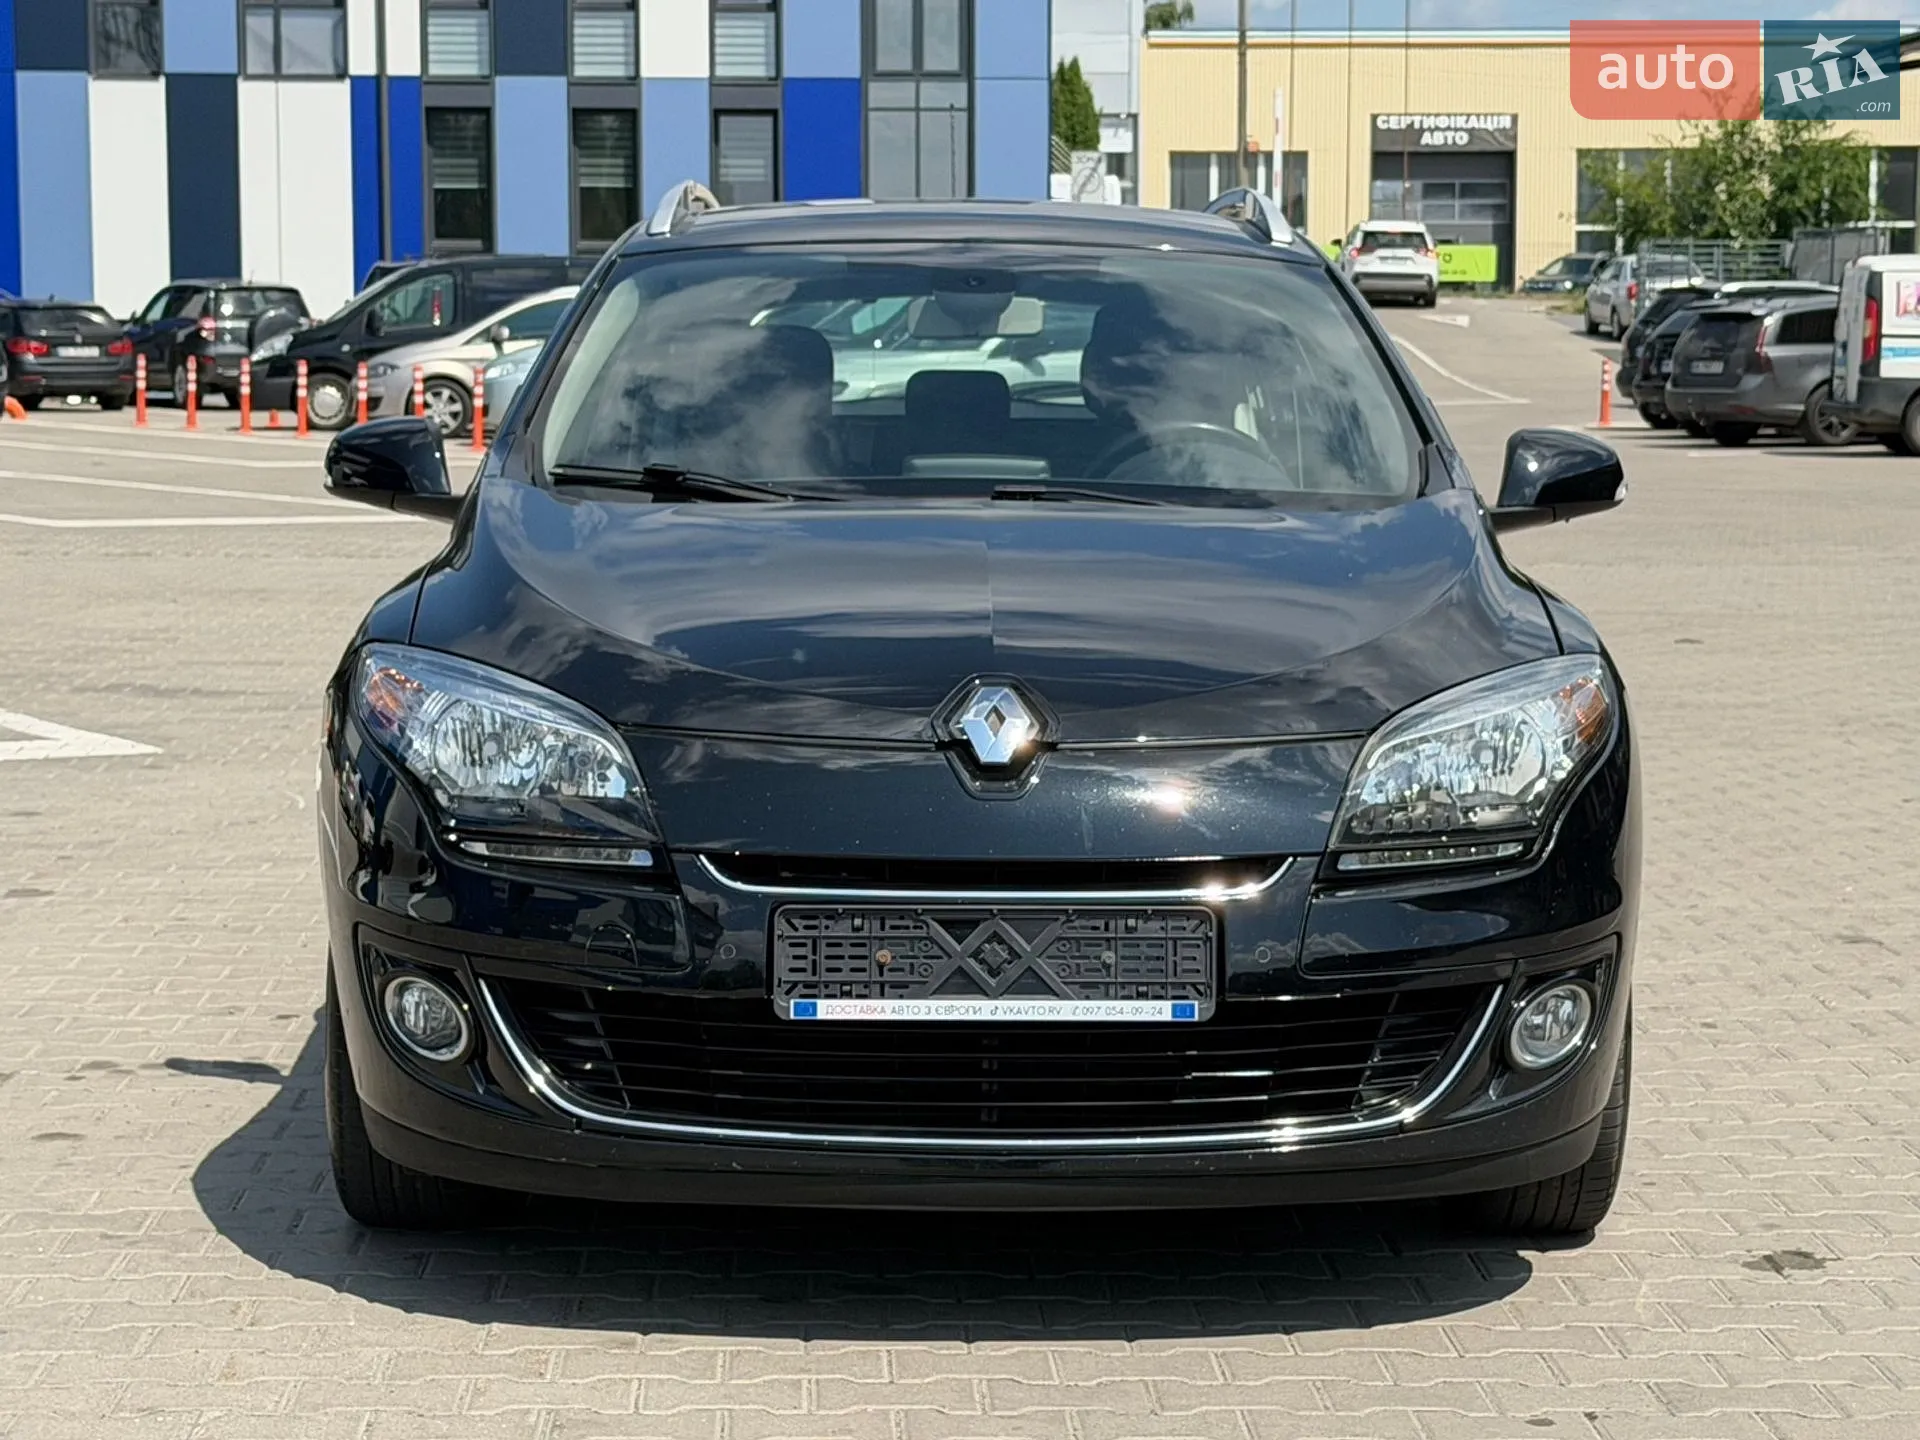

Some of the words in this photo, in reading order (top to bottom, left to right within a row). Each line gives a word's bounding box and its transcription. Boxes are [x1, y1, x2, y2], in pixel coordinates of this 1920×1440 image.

[1376, 115, 1512, 130] СЕРТИФІКАЦІЯ
[1420, 131, 1469, 146] АВТО
[825, 1004, 886, 1016] ДОСТАВКА
[890, 1004, 921, 1016] АВТО
[935, 1004, 982, 1016] ЄВРОПИ
[1081, 1004, 1100, 1016] 097
[1105, 1004, 1163, 1016] 054-09-24
